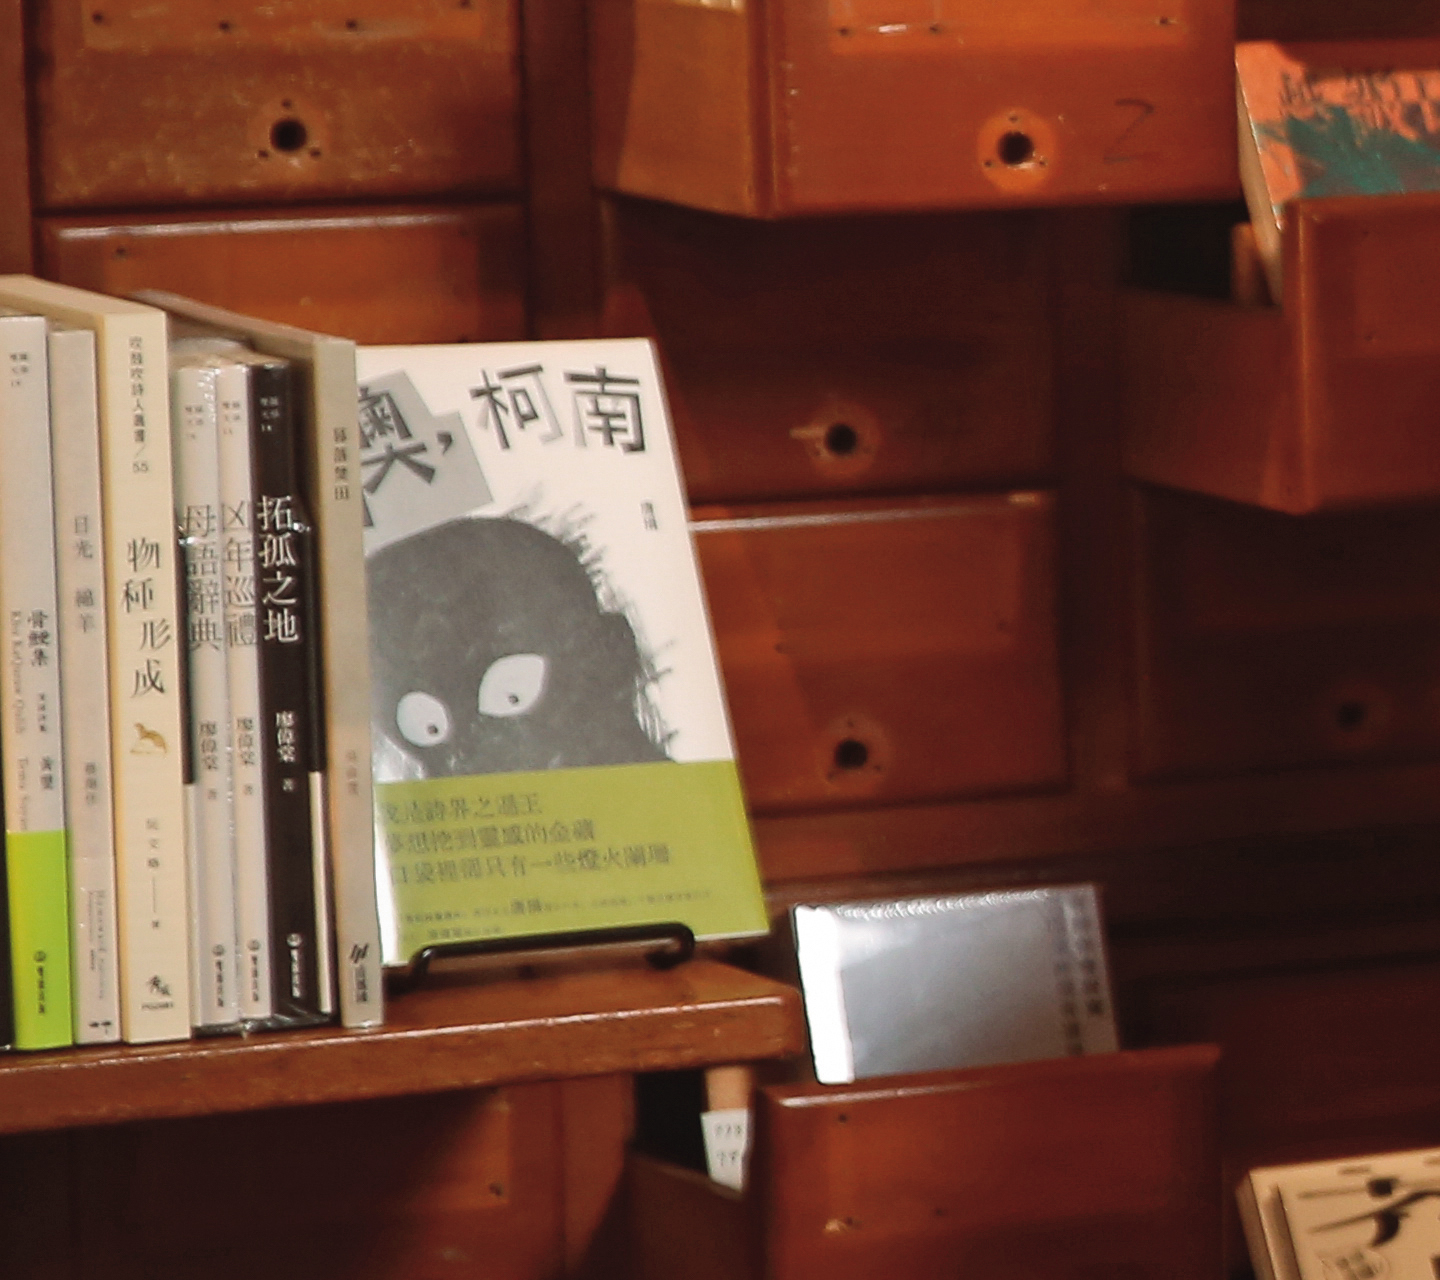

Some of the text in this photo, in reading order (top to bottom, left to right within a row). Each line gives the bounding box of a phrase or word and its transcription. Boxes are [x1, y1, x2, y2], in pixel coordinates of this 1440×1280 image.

[122, 535, 174, 699] 物種形成
[183, 503, 222, 652] 母語辭典
[221, 500, 257, 649] 凶年巡禮
[256, 493, 300, 645] 拓孤之地
